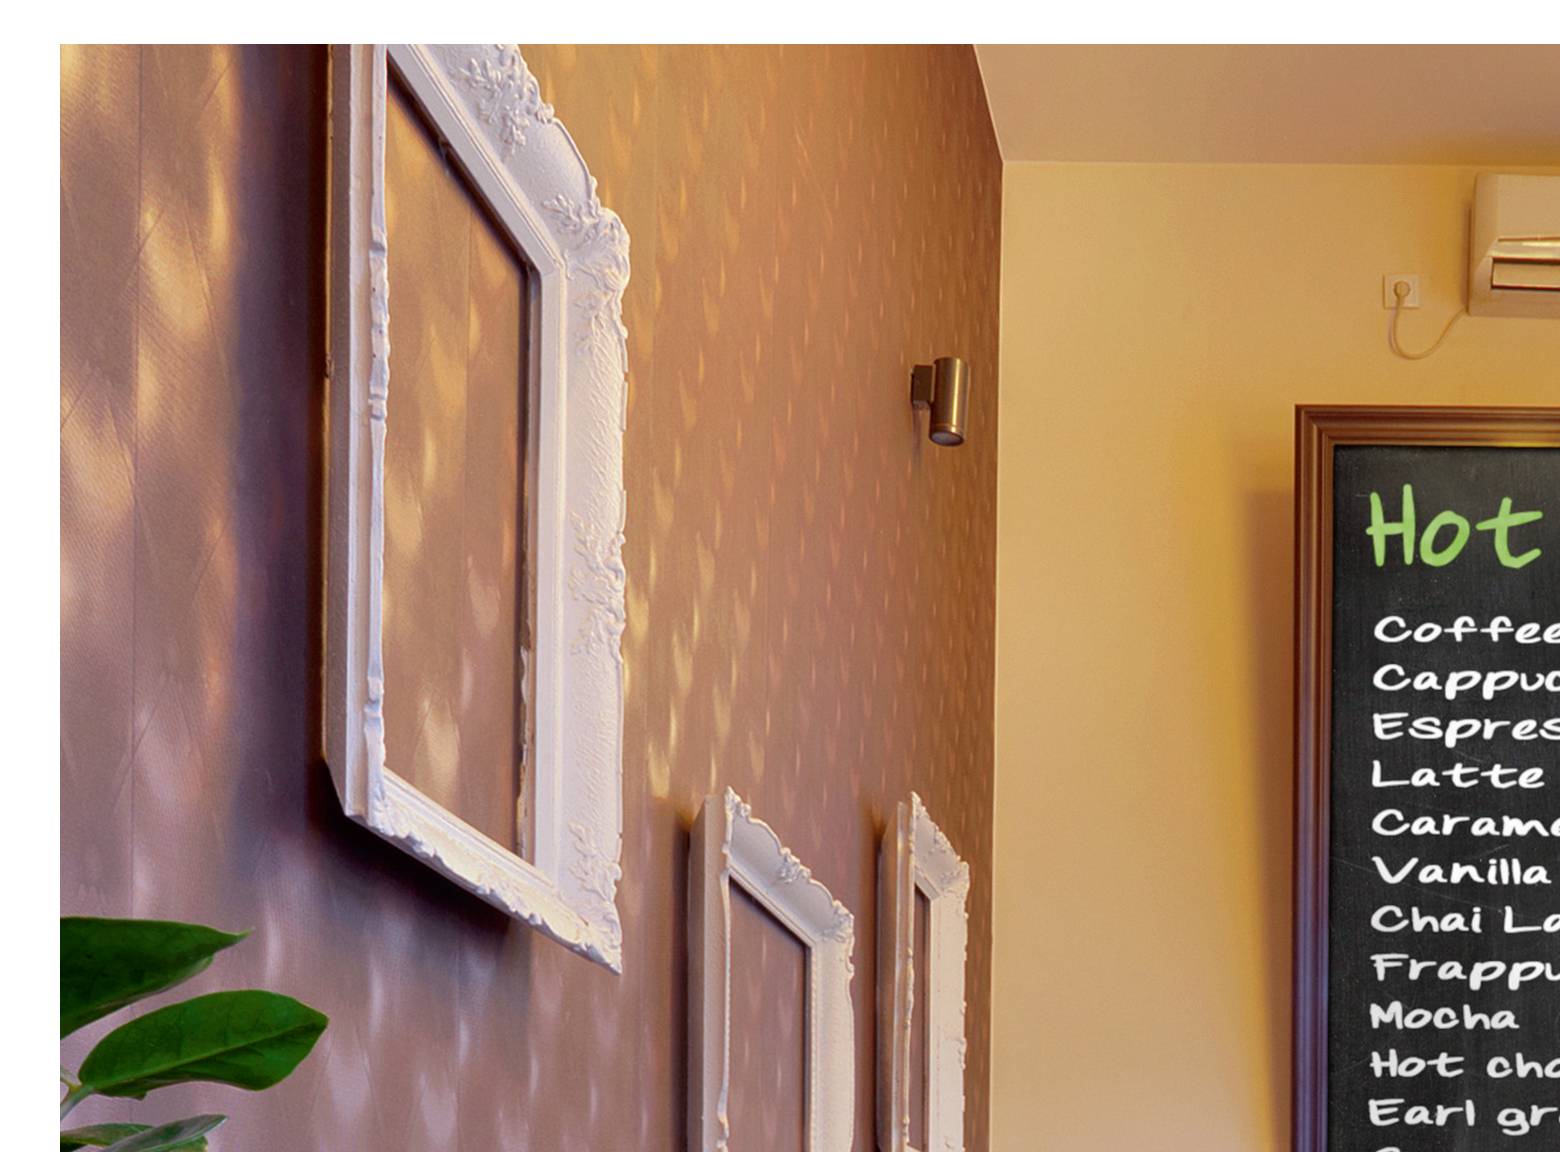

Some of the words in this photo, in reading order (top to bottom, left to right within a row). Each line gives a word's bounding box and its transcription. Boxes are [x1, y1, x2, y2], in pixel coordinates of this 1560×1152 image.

[1365, 483, 1543, 569] Hot
[1371, 759, 1545, 789] Latte
[1371, 855, 1552, 885] Vanilla
[1370, 904, 1482, 934] Chai
[1369, 1000, 1520, 1030] Mocha
[1369, 1048, 1465, 1078] Hot
[1368, 1098, 1476, 1127] Earl
